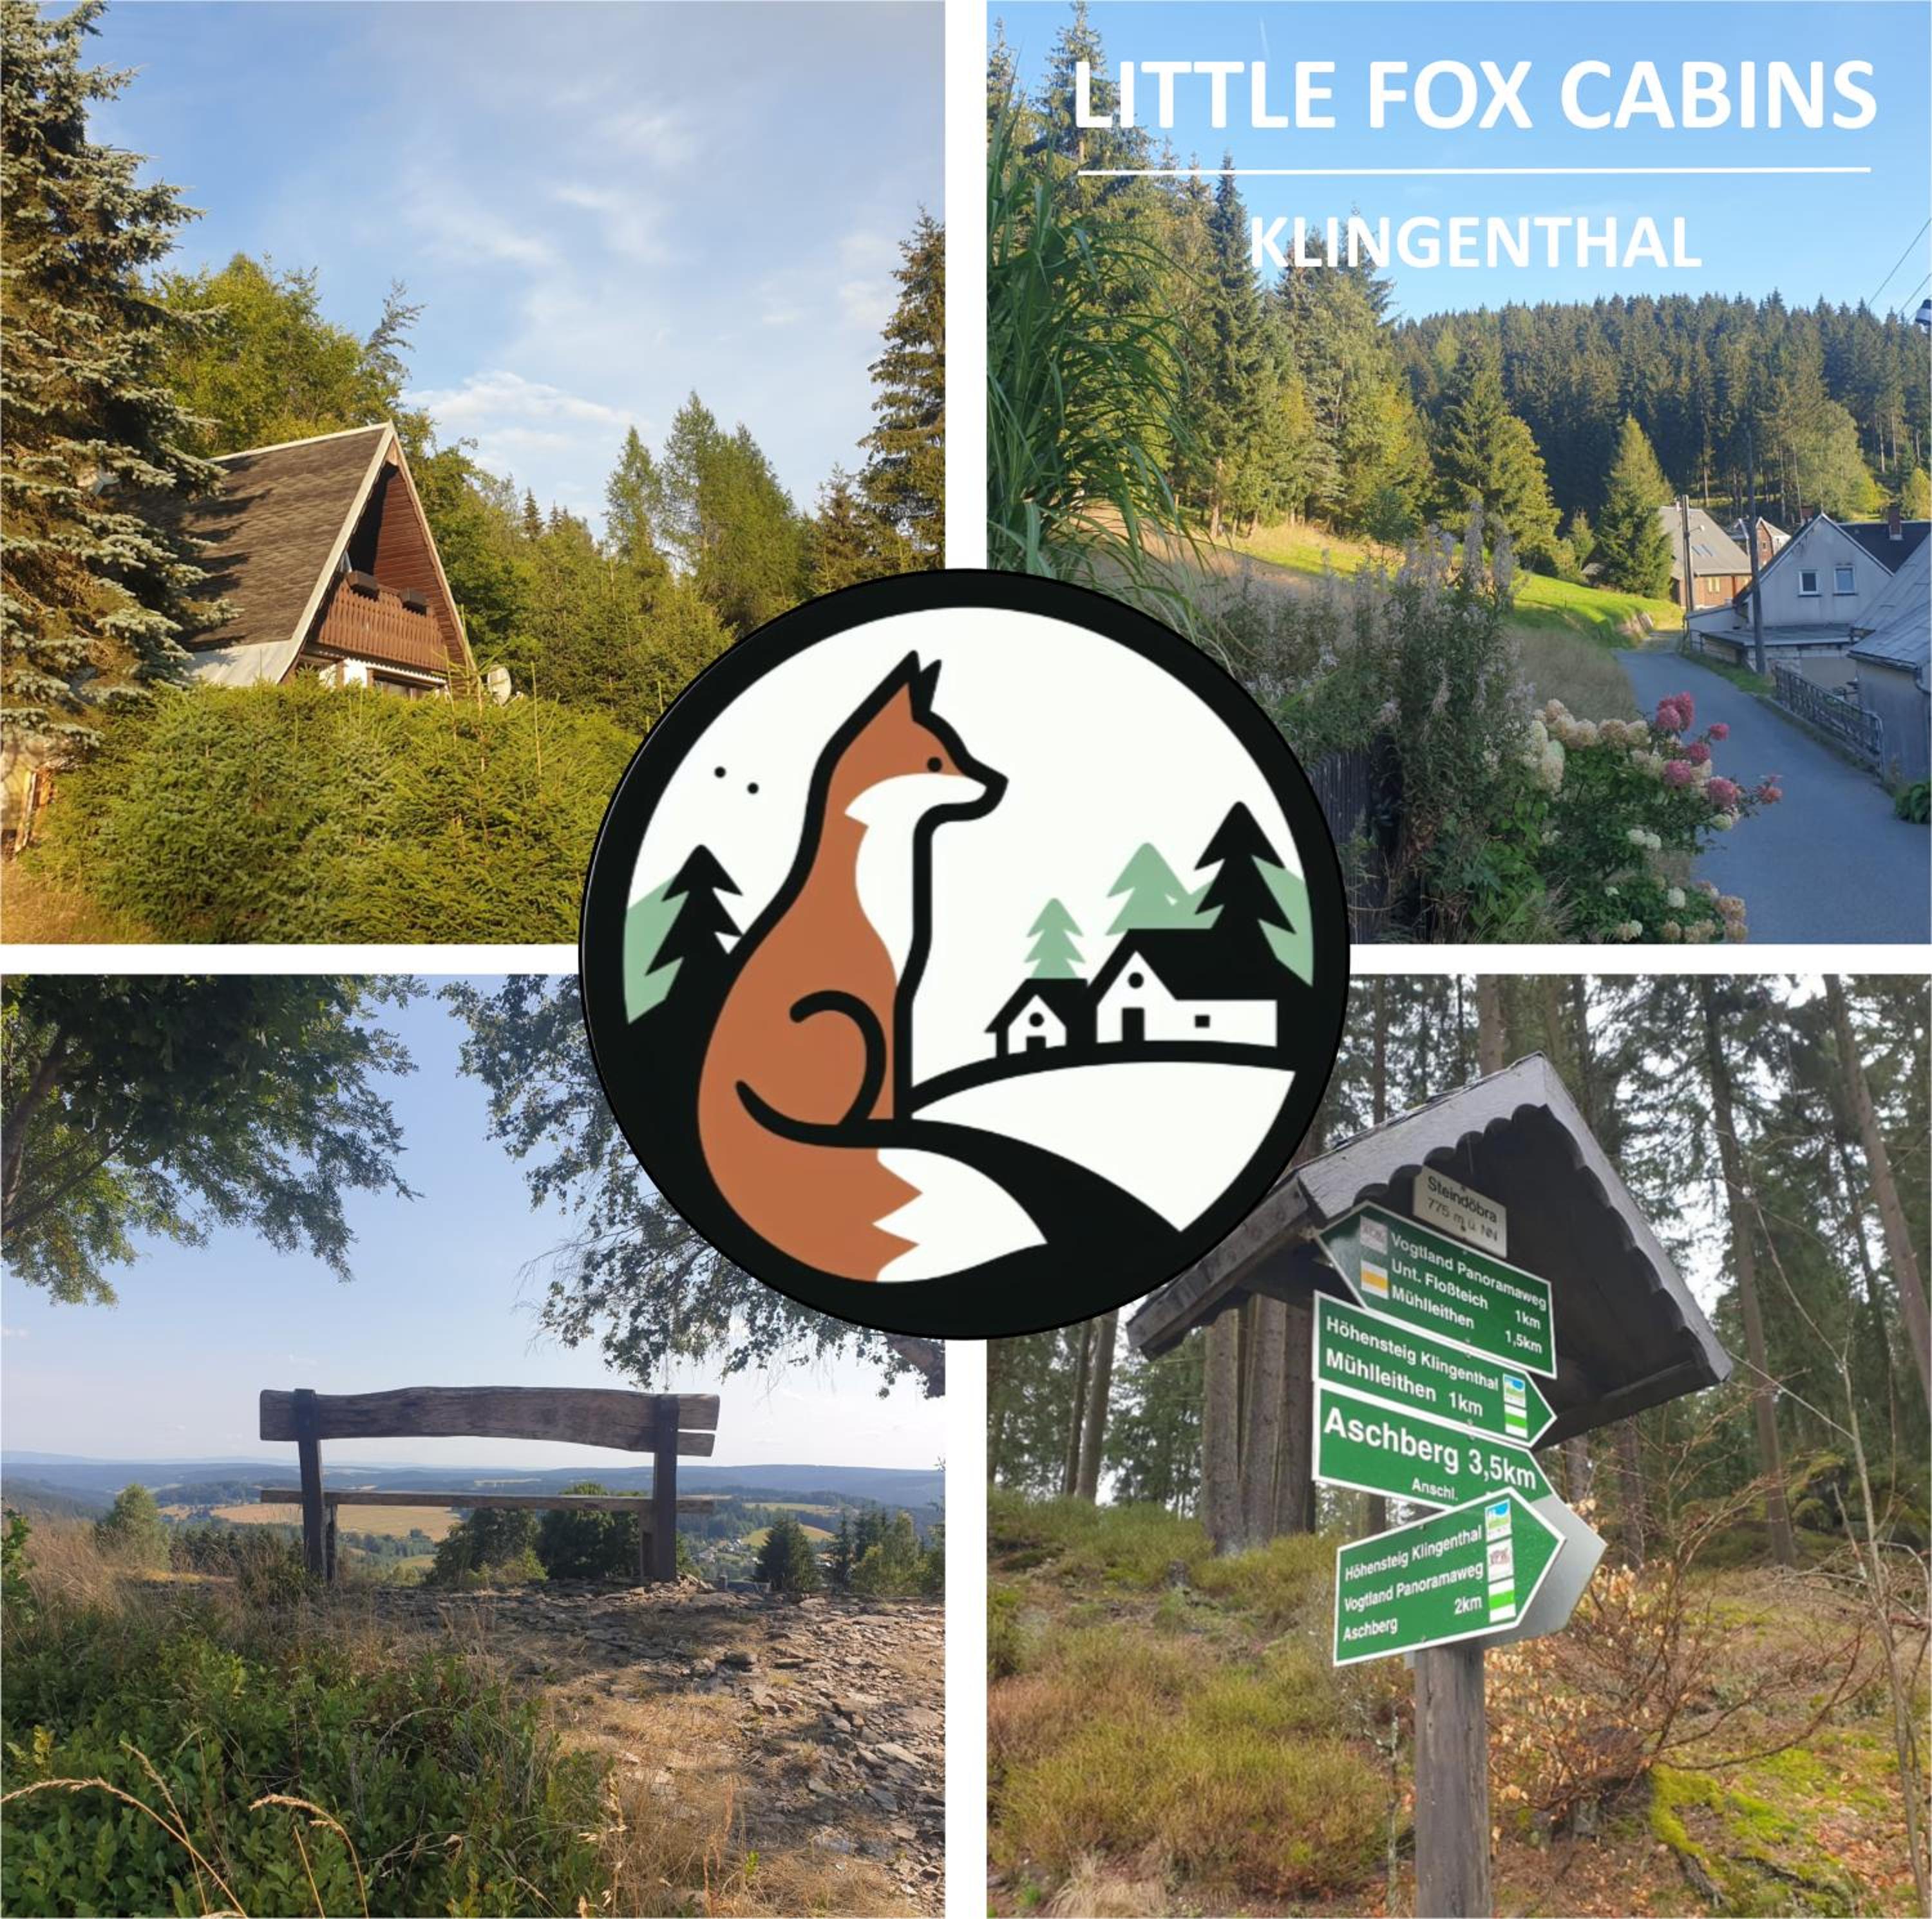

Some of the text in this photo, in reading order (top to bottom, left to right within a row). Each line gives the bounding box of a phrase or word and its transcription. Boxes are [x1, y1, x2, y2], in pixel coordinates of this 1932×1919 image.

[1428, 1176, 1497, 1223] Steindöbra
[1428, 1197, 1449, 1218] 775
[1391, 1233, 1454, 1271] Vogtland
[1457, 1264, 1547, 1312] Panoramaweg
[1392, 1259, 1541, 1330] Unt. Floßteich 1km
[1392, 1285, 1542, 1354] Mühlleithen 1,5km
[1325, 1348, 1484, 1417] Mühlleithen 1km
[1326, 1316, 1499, 1392] Höhensteig Klingenthal
[1324, 1407, 1537, 1490] Aschberg 3,5km
[1412, 1477, 1459, 1501] Anschl.
[1345, 1551, 1408, 1582] Höhensteig
[1412, 1525, 1482, 1560] Klingenthal
[1343, 1595, 1482, 1642] Aschberg 2km
[1344, 1562, 1484, 1612] Vogtland Panoramaweg
